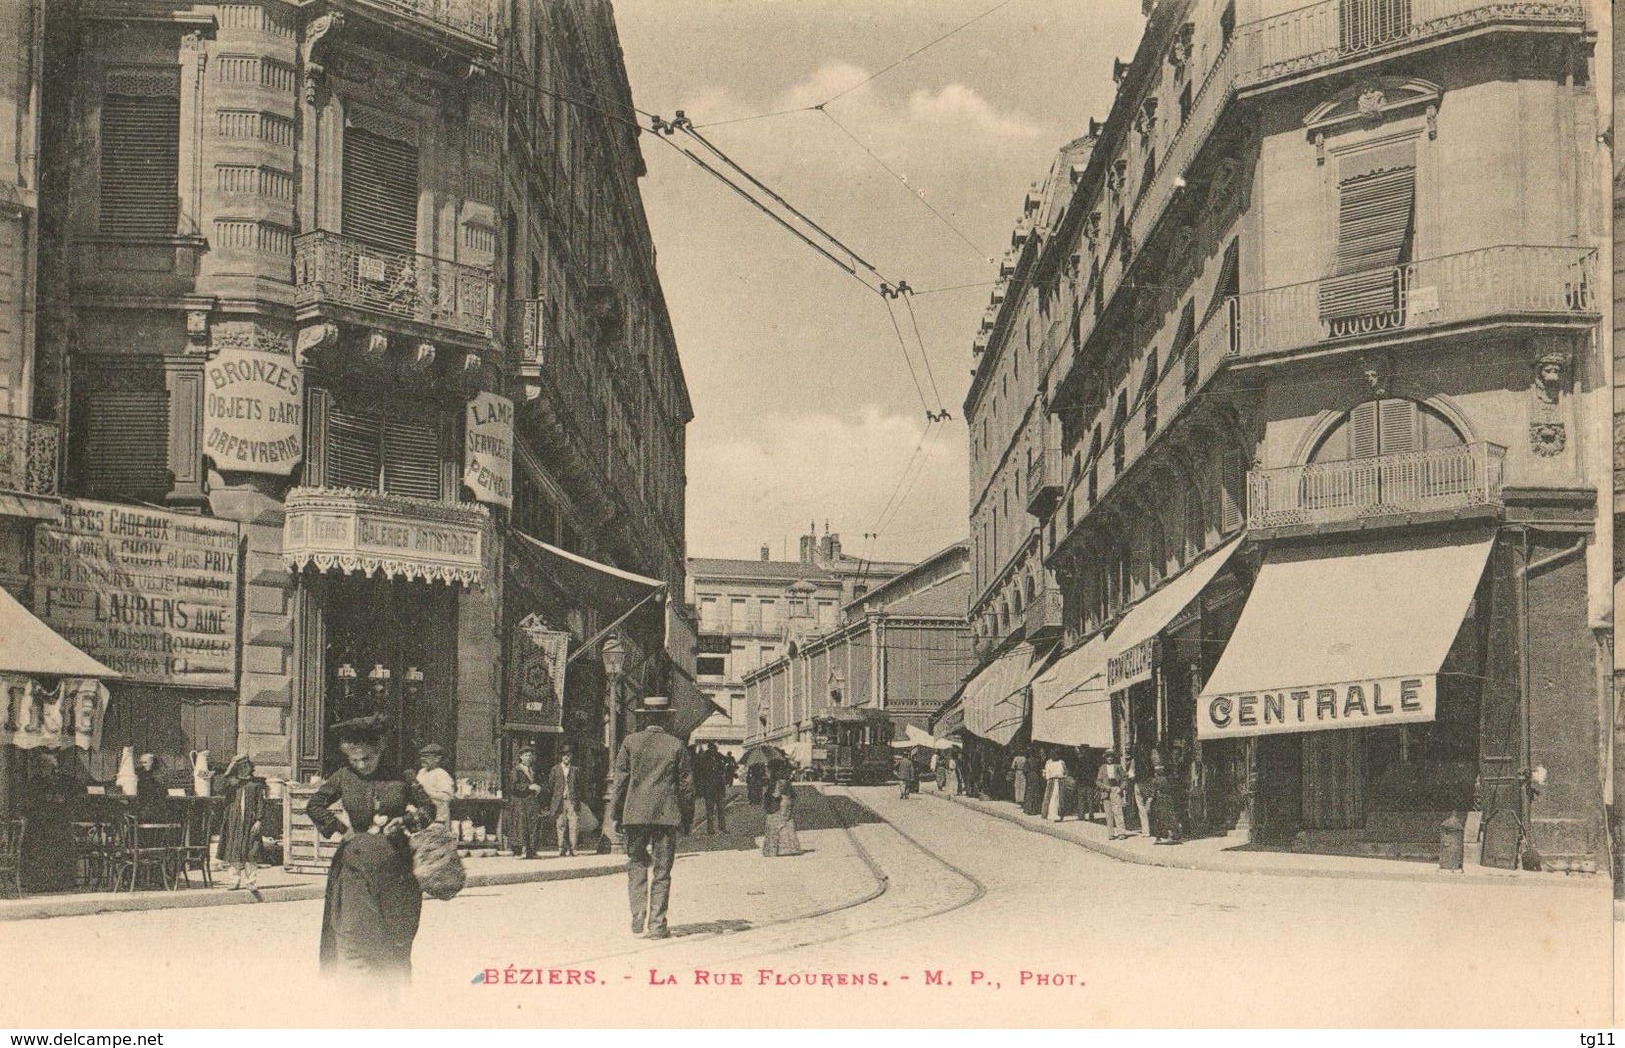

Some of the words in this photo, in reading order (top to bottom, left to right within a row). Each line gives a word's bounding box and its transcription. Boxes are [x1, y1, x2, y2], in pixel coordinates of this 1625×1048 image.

[208, 359, 299, 396] BRONZES
[208, 393, 262, 420] OBJETS
[109, 508, 169, 541] CADEAUX
[120, 540, 163, 566] CHOIX
[204, 550, 234, 575] PRIX
[94, 591, 189, 629] LAURENS
[109, 627, 158, 651] Maison
[1208, 679, 1423, 729] CENTRALE
